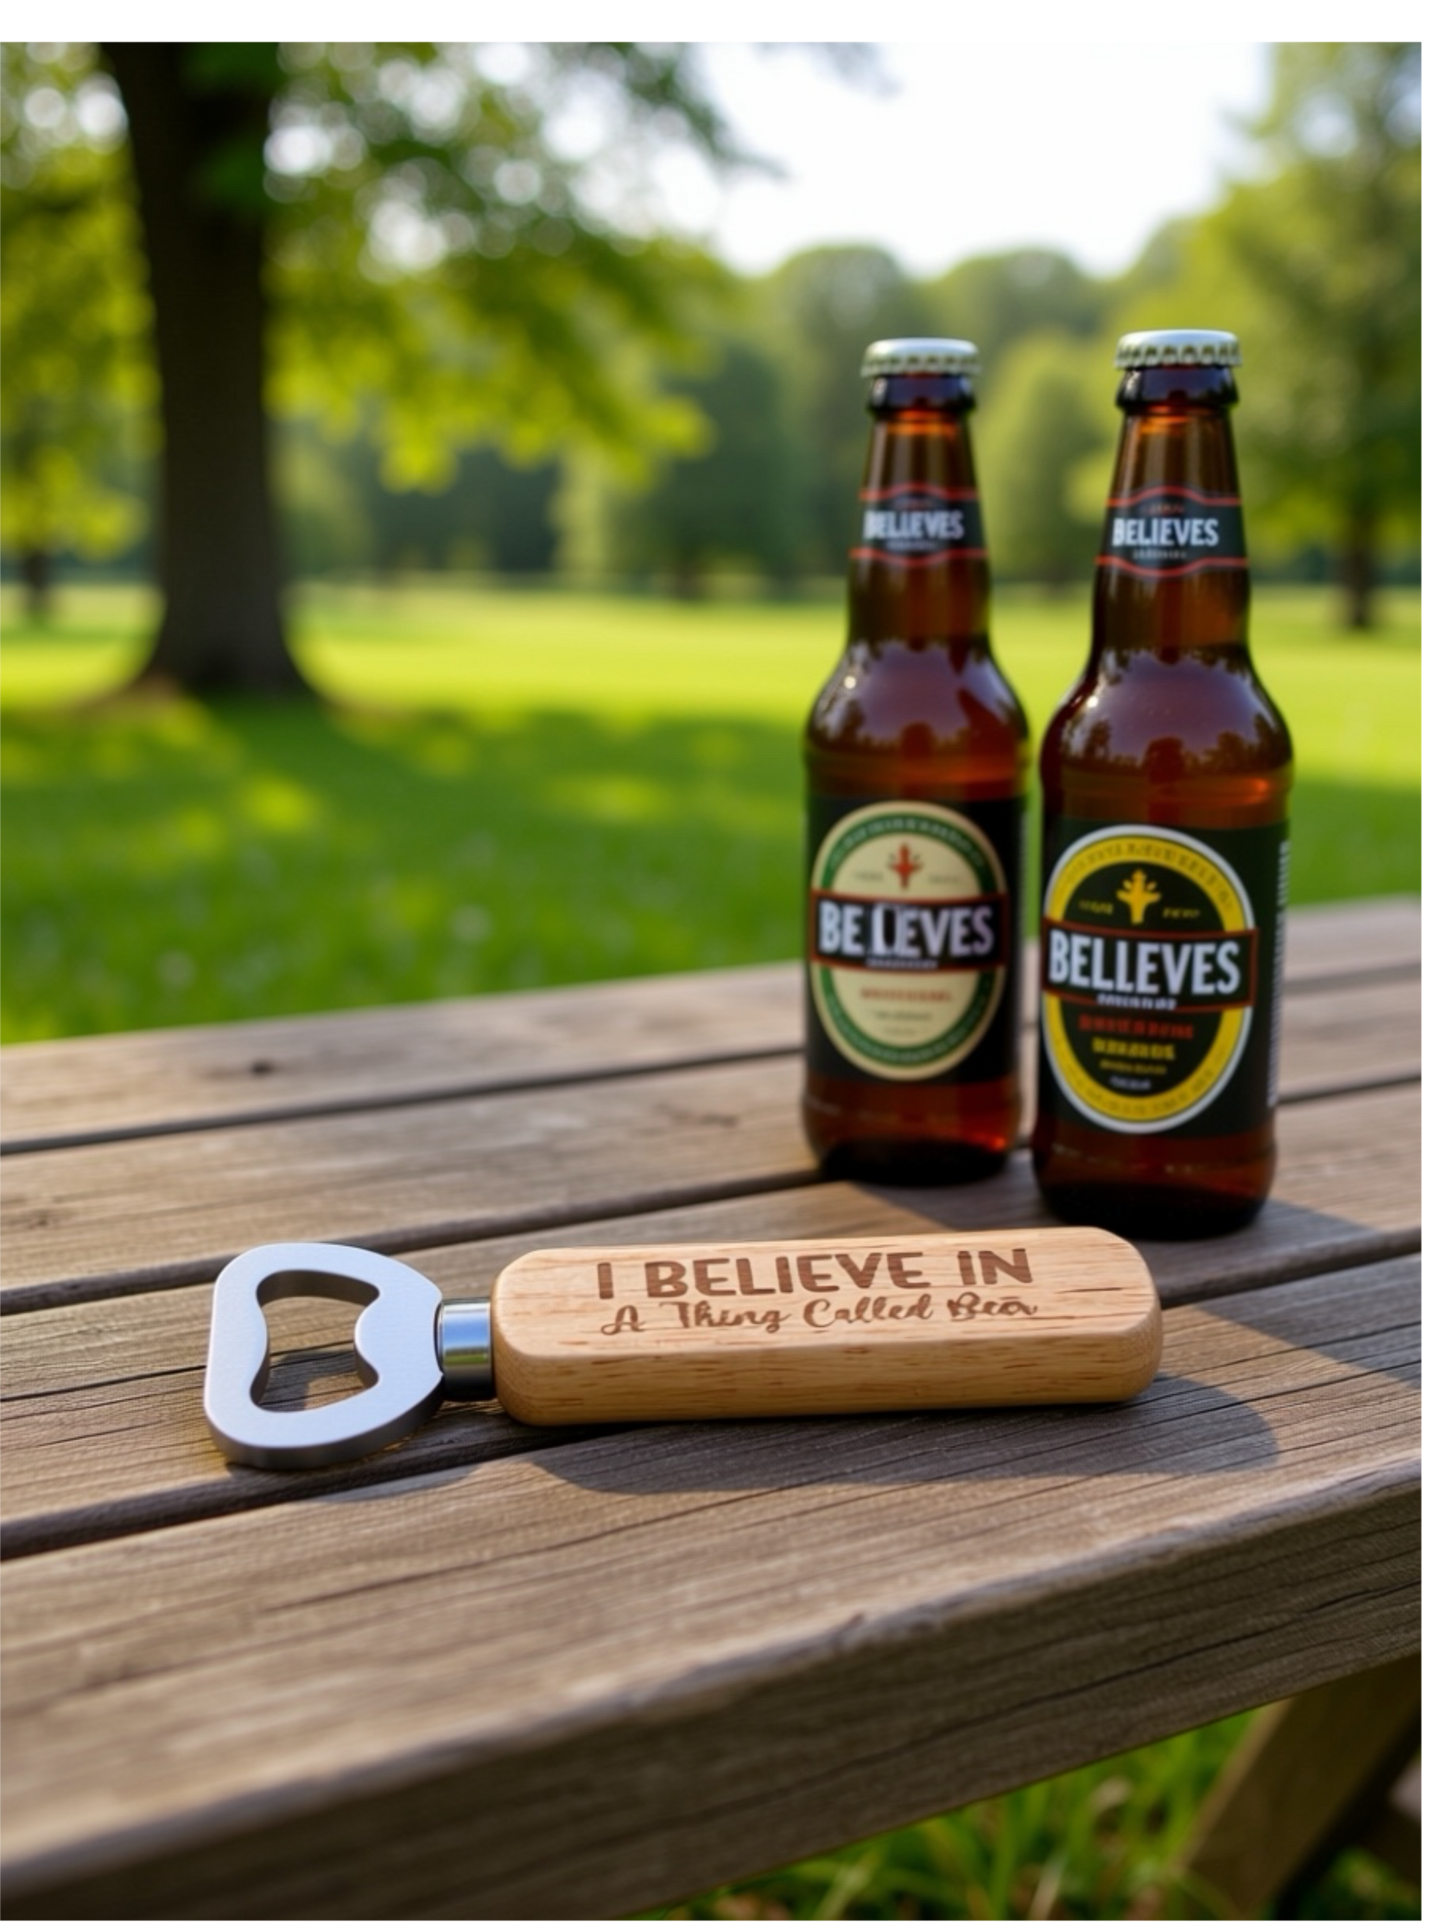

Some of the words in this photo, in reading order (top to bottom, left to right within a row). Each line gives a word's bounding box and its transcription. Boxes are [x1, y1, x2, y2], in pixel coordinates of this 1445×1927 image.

[1111, 517, 1220, 547] BELIEVES
[597, 1262, 614, 1299] I
[644, 1251, 932, 1298] BELIEVE
[957, 1248, 1034, 1285] IN
[600, 1304, 646, 1335] A
[659, 1300, 792, 1334] Thing
[803, 1293, 933, 1328] Called
